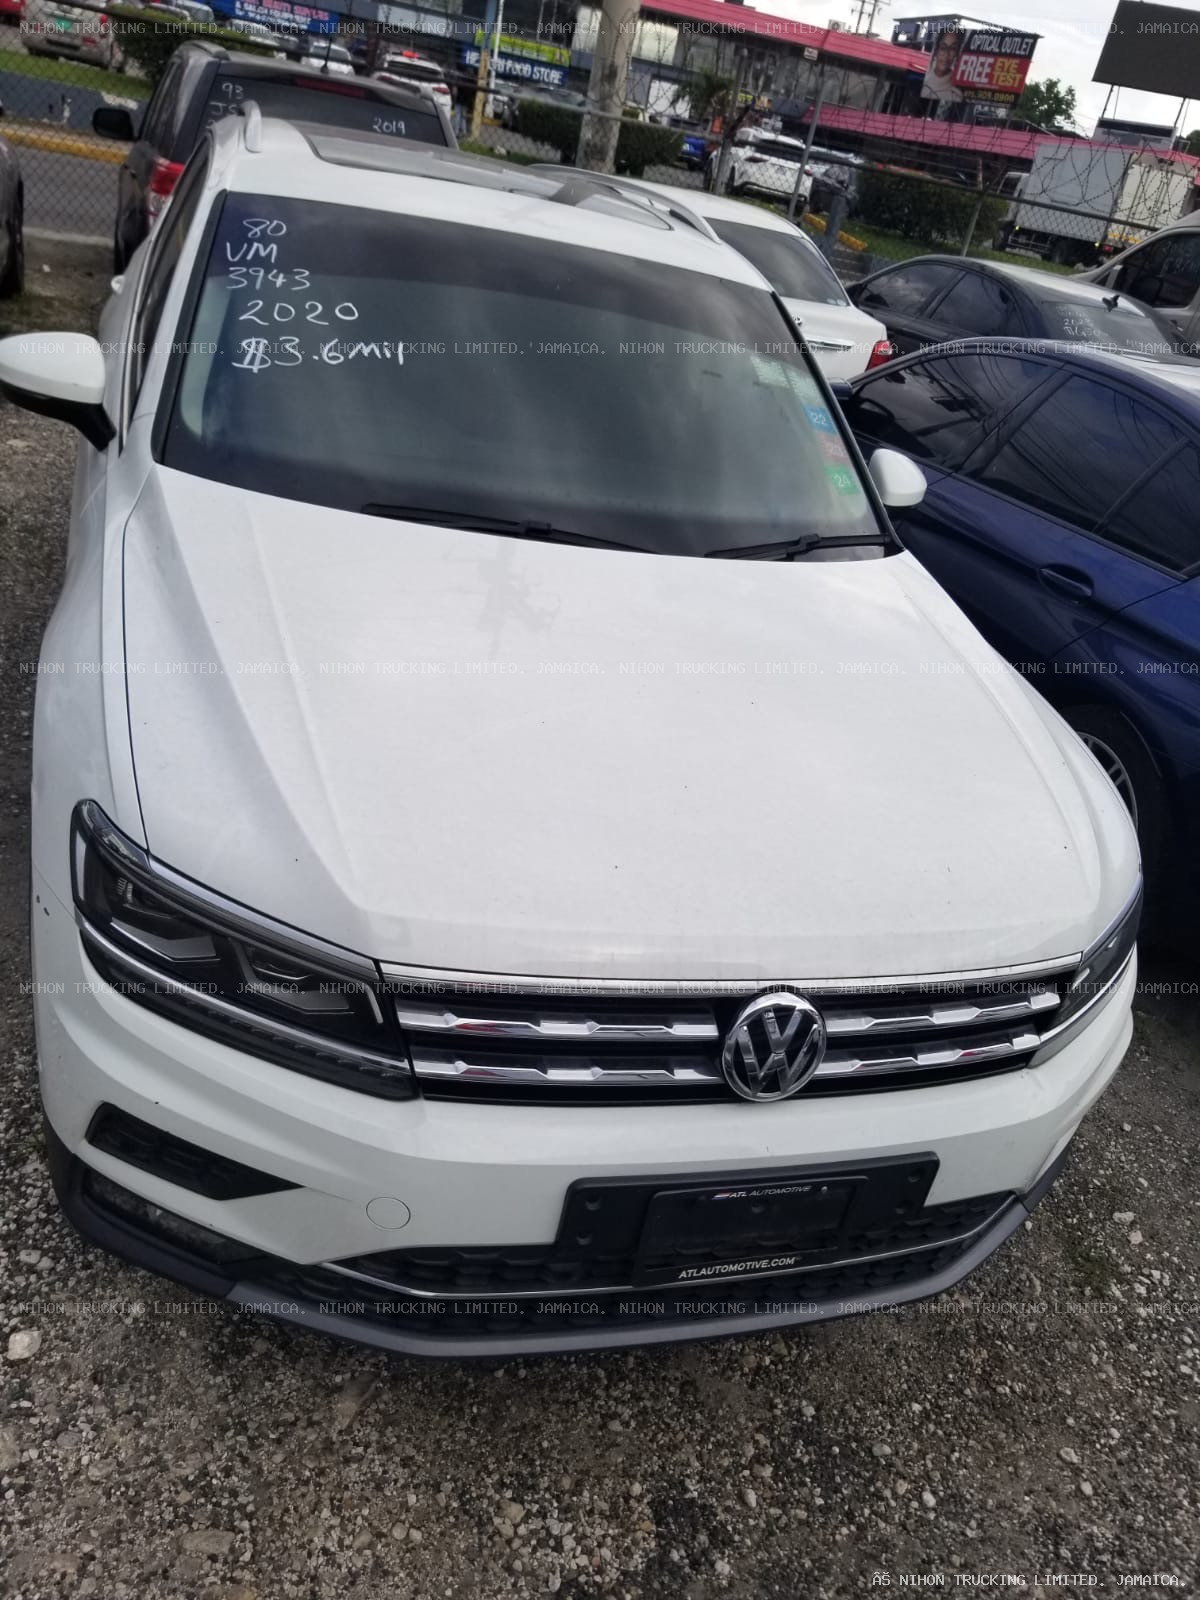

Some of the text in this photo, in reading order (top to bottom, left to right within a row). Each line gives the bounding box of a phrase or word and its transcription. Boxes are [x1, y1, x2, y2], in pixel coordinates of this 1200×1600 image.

[970, 34, 1034, 56] OPTICAL OUTLET
[465, 50, 506, 74] HELTH
[506, 60, 532, 78] FOOD
[532, 66, 565, 85] STORE
[956, 54, 995, 83] FREE
[995, 57, 1019, 73] EYE
[992, 73, 1023, 88] TEST
[372, 117, 406, 135] 2019
[243, 218, 287, 238] 80
[226, 267, 311, 290] 3943
[239, 300, 359, 325] 2020
[729, 1185, 813, 1199] ATL AUTOMOTIVE
[678, 1256, 797, 1279] ATLAUTOMOTIVE.COM
